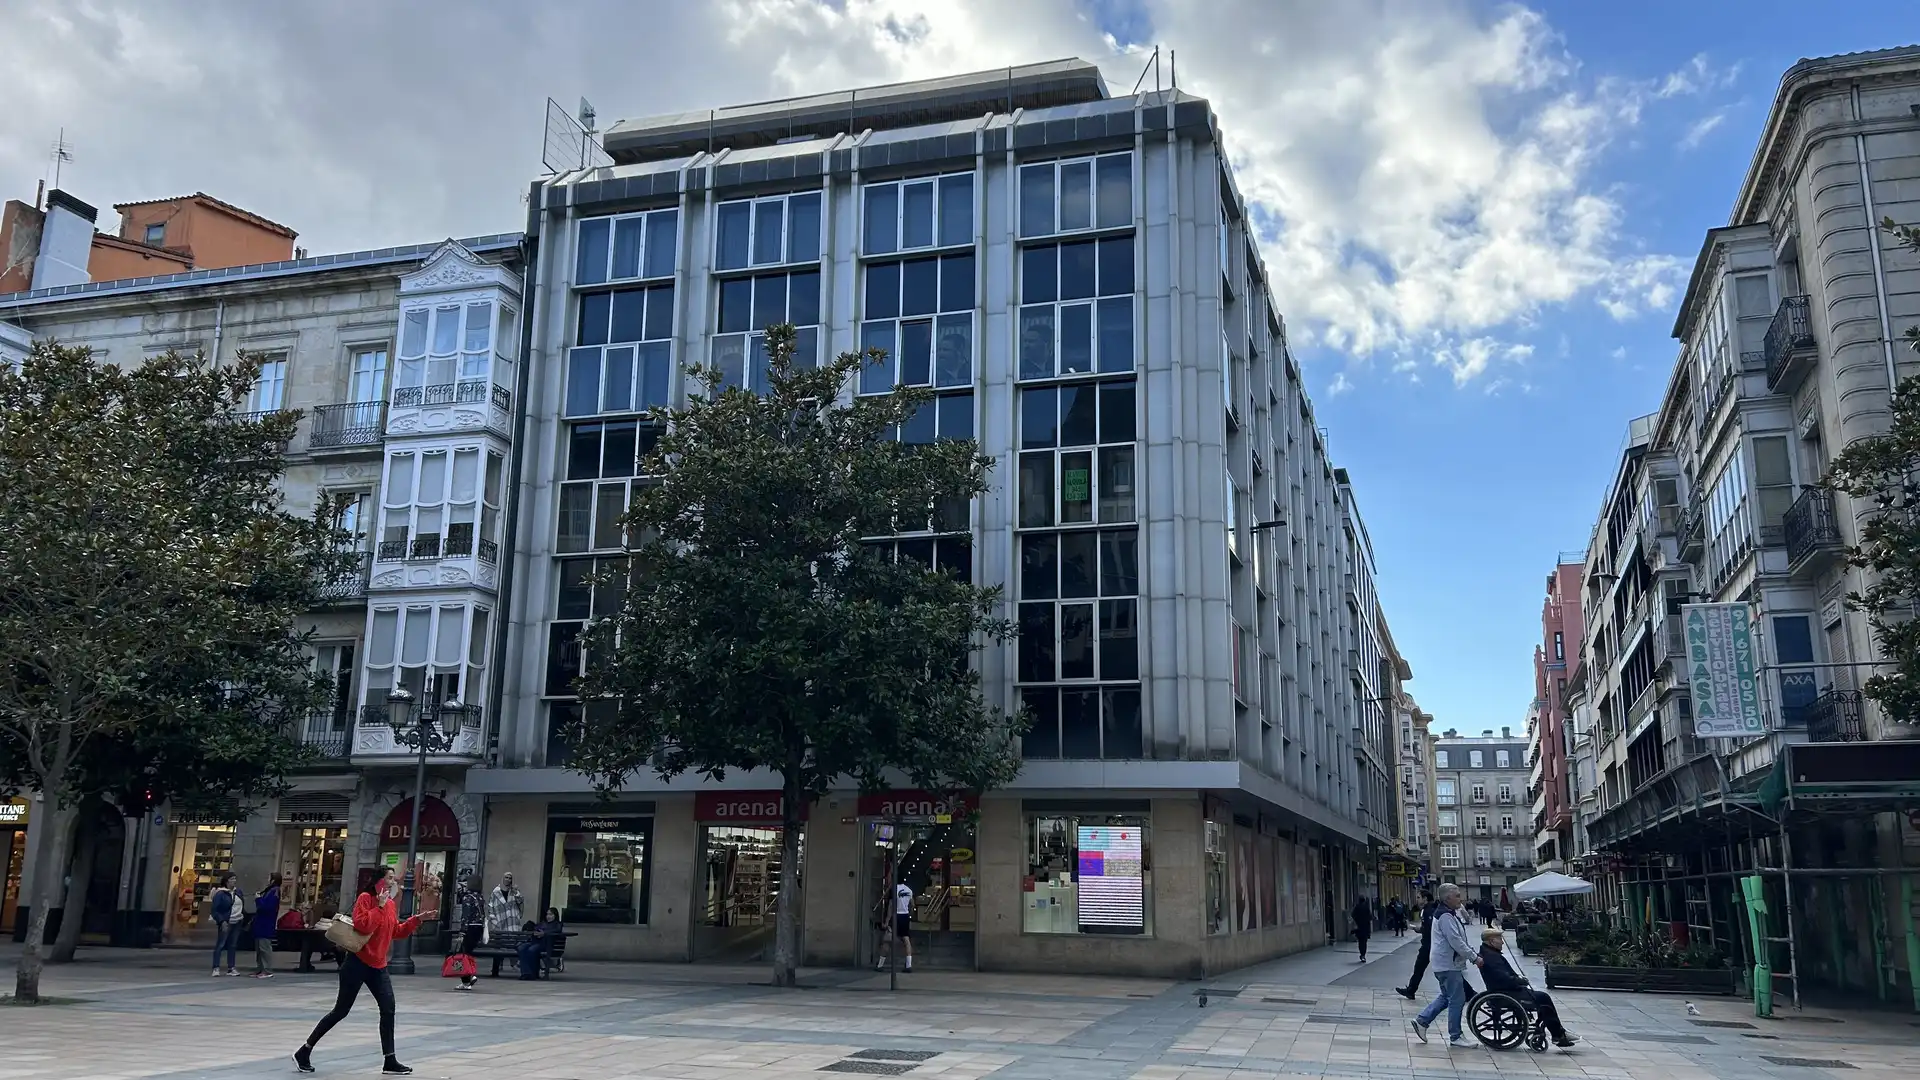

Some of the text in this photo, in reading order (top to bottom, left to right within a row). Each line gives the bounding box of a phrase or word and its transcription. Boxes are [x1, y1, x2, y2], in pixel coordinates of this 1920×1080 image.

[1687, 608, 1716, 719] ANBASA
[1732, 609, 1760, 728] 94 671 05 50
[1784, 675, 1814, 686] AXA
[716, 797, 784, 816] arenal
[291, 812, 335, 822] BOTIKA
[583, 868, 618, 880] LIBRE
